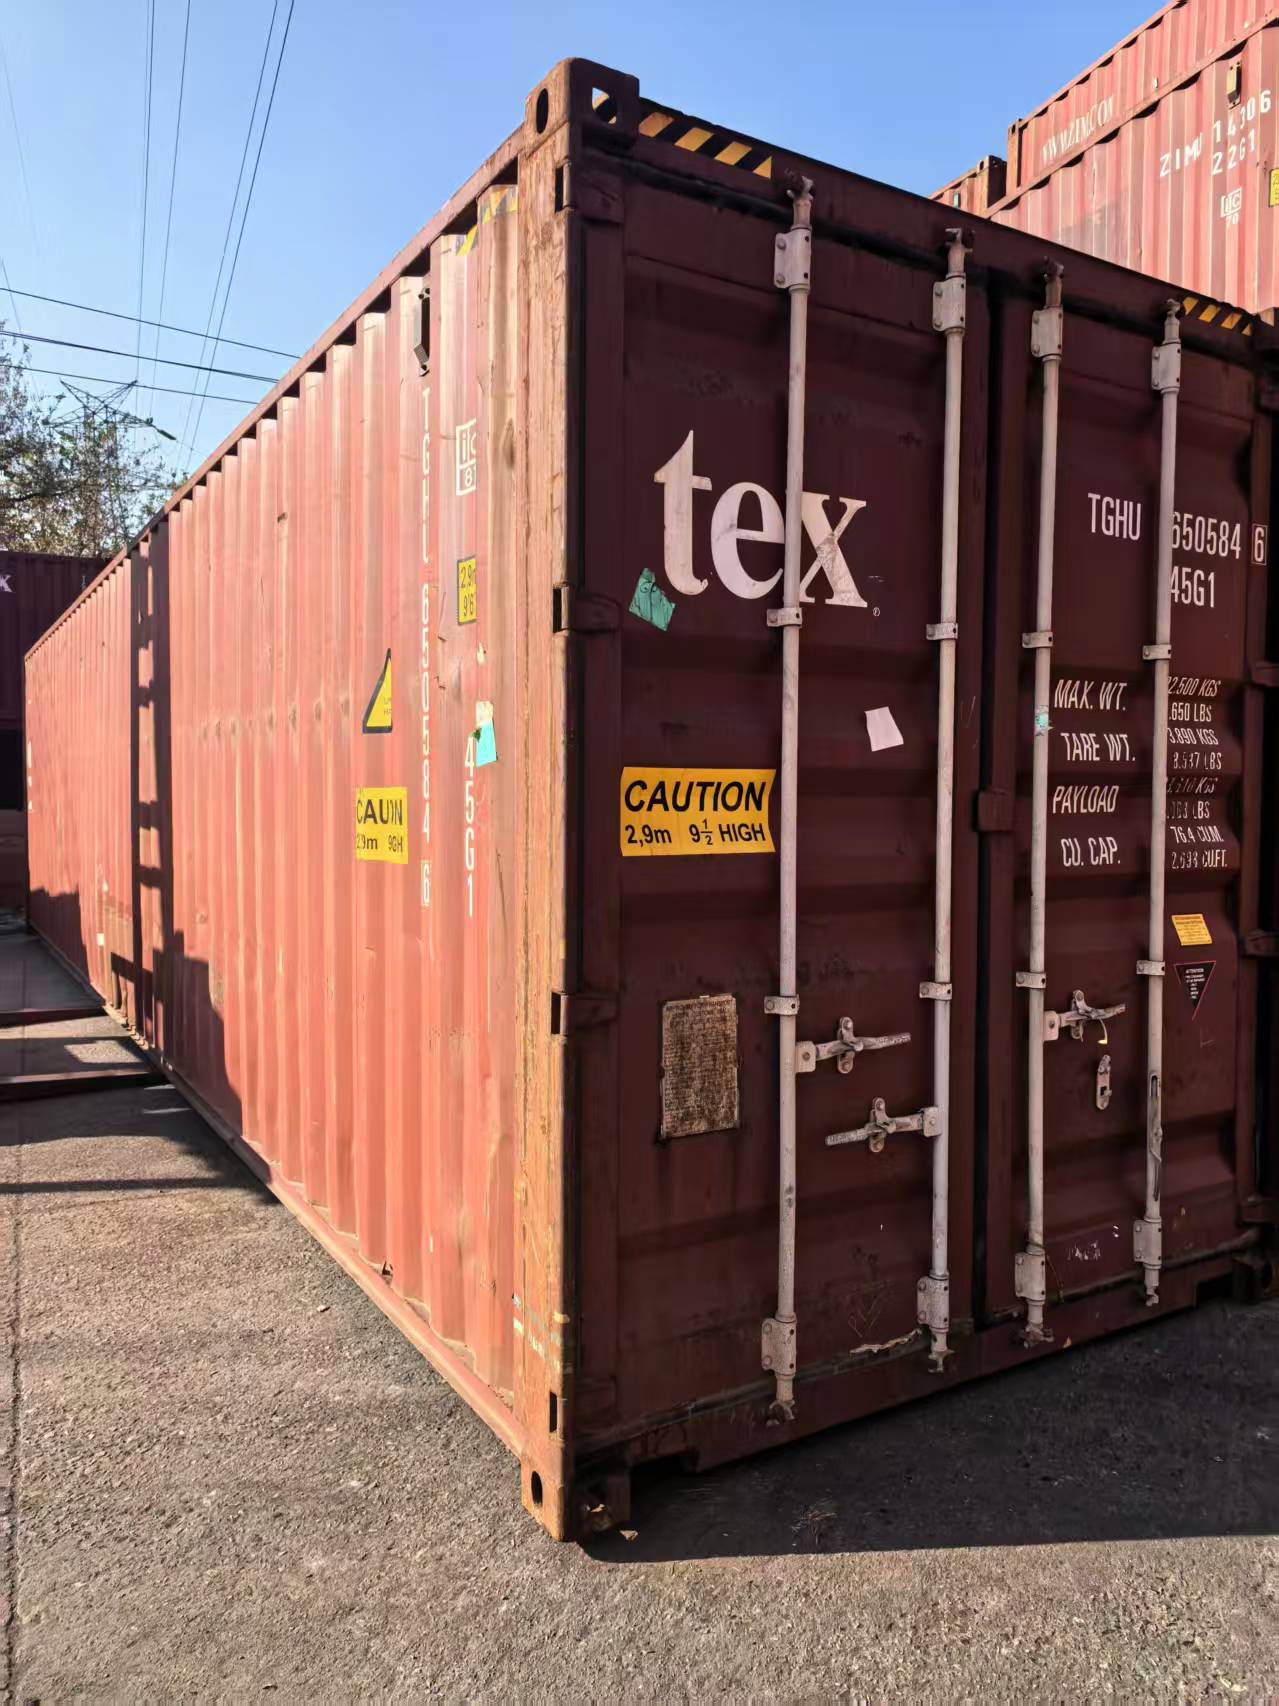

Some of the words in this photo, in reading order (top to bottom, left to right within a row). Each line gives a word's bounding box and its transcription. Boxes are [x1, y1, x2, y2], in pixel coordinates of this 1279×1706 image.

[654, 430, 867, 608] tex
[1087, 492, 1141, 540] TGHU
[1171, 511, 1241, 559] 650584
[1254, 527, 1265, 563] 6
[1171, 565, 1215, 608] 45G1
[1054, 680, 1094, 709] MAX.
[1100, 682, 1127, 711] WT.
[1198, 679, 1221, 696] KGS
[1194, 703, 1212, 722] LBS
[1061, 733, 1100, 761] TARE
[1104, 734, 1136, 761] WT.
[1196, 728, 1219, 745] KGS
[1204, 752, 1222, 769] LBS
[624, 780, 766, 813] CAUTION
[1053, 785, 1120, 814] PAYLOAD
[465, 735, 475, 917] 45G1
[624, 824, 672, 847] 2,9m
[718, 822, 766, 843] HIGH
[1061, 838, 1084, 866] CU.
[1088, 837, 1121, 865] CAP.
[1169, 826, 1196, 844] 76.4
